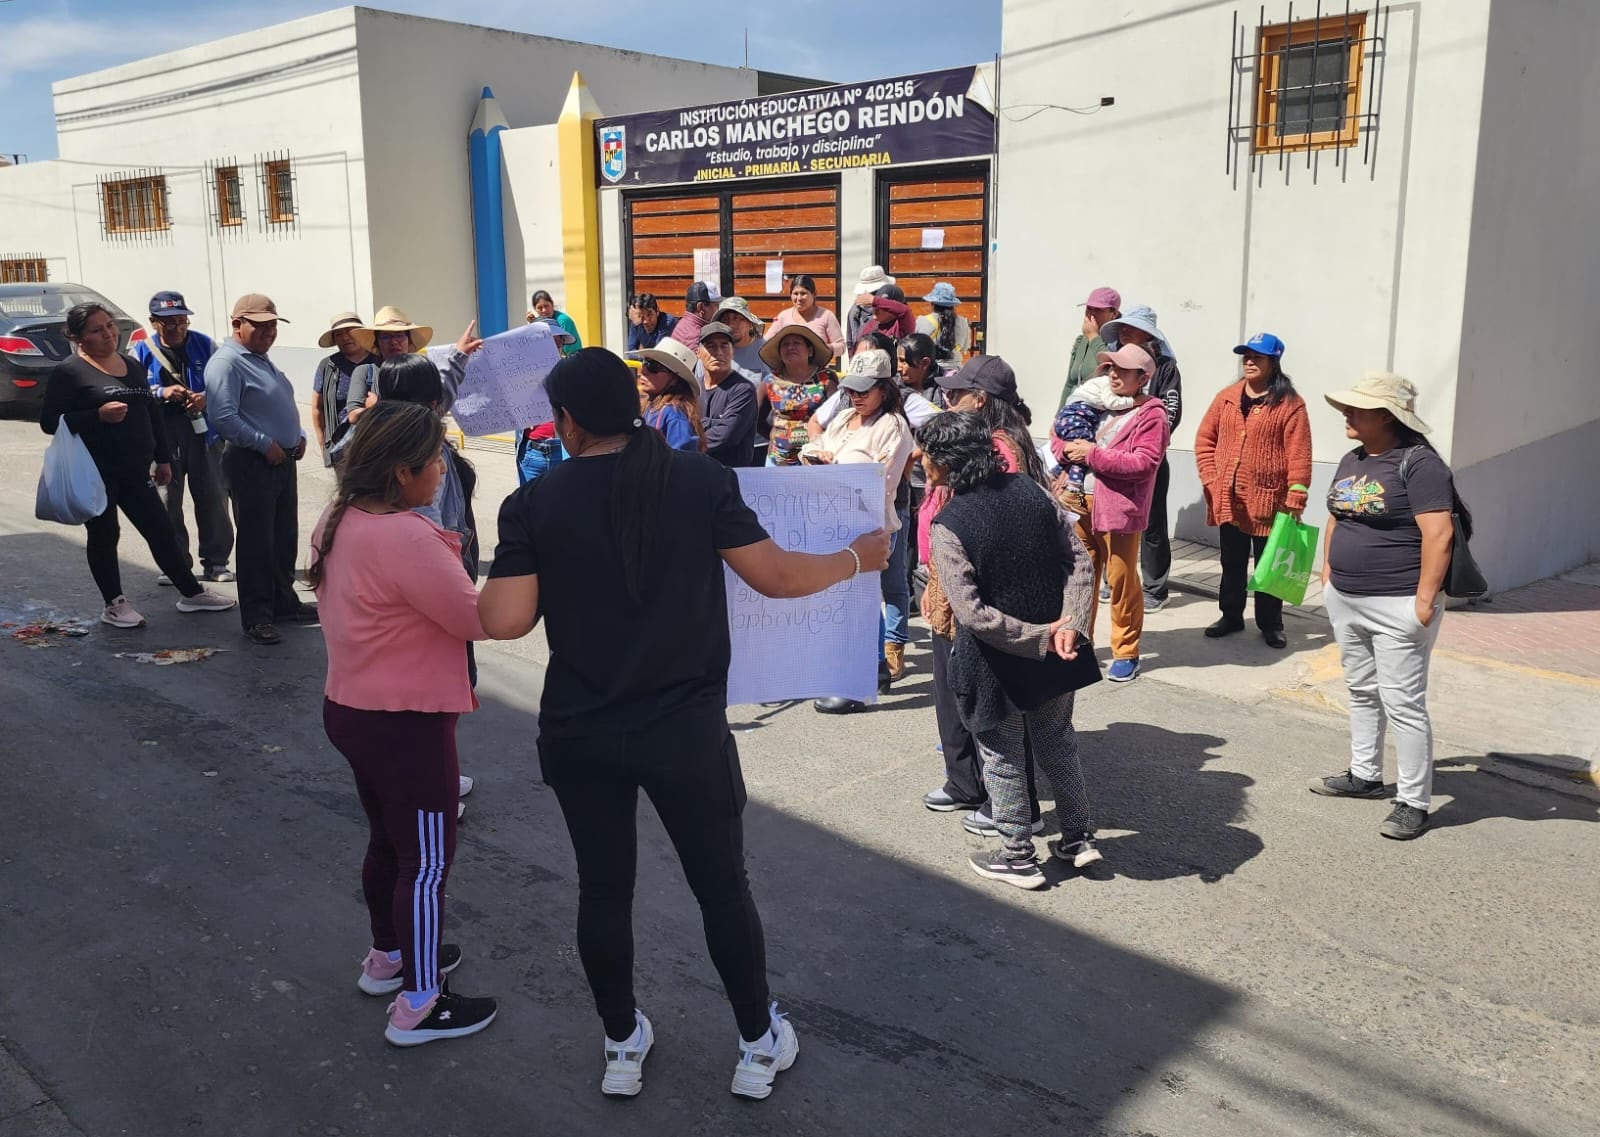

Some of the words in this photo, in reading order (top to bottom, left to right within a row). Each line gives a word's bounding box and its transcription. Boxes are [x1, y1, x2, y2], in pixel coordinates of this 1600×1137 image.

[645, 126, 720, 152] CARLOS
[726, 109, 850, 144] MANCHEGO
[858, 91, 964, 129] RENDÓN
[680, 100, 758, 127] INSTITUCIÓN
[761, 91, 841, 116] EDUCATIVA
[865, 80, 914, 101] 40256
[697, 167, 736, 181] INICIAL
[745, 161, 800, 176] PRIMARIA
[810, 152, 892, 171] SECUNDARIA
[756, 143, 798, 160] trabajo
[801, 144, 809, 159] y
